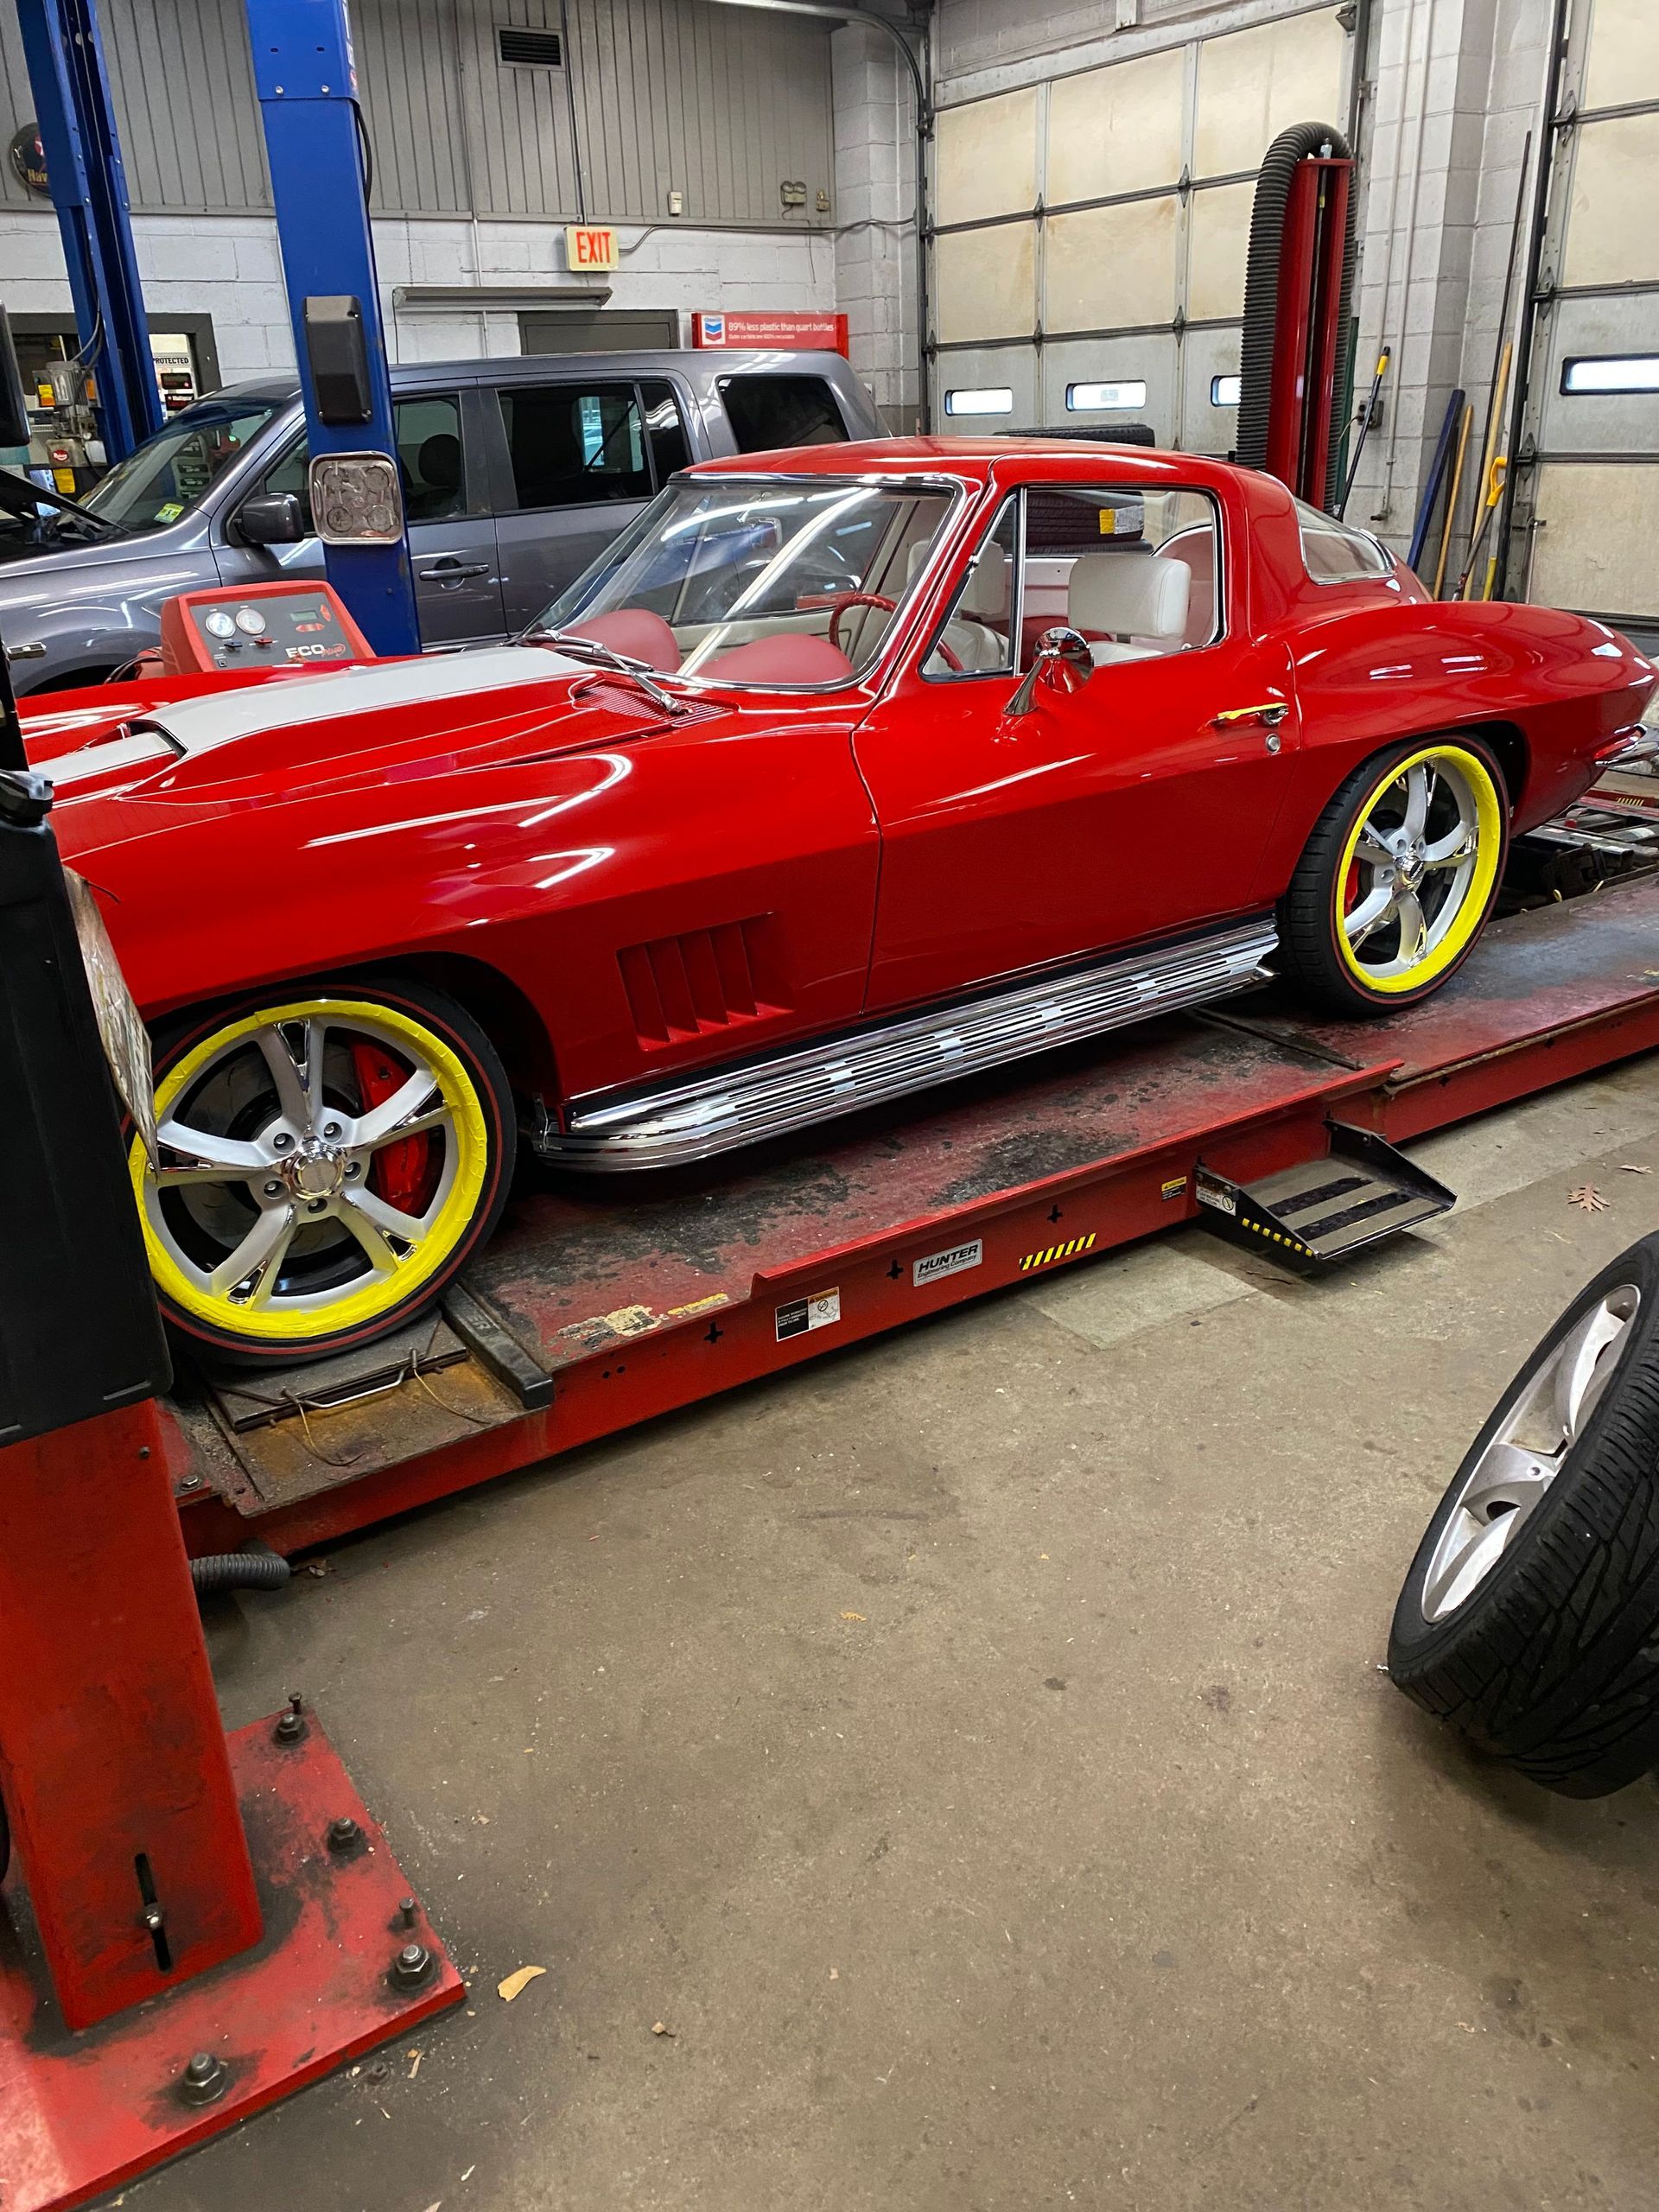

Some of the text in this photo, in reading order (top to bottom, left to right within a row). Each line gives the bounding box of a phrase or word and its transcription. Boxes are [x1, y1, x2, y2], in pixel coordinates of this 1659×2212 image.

[575, 232, 611, 264] EXIT
[728, 322, 834, 333] 89% less plastic than quart bottles
[285, 644, 325, 658] ECO
[918, 1244, 978, 1273] HUNTER
[918, 1254, 977, 1279] Engineering Company
